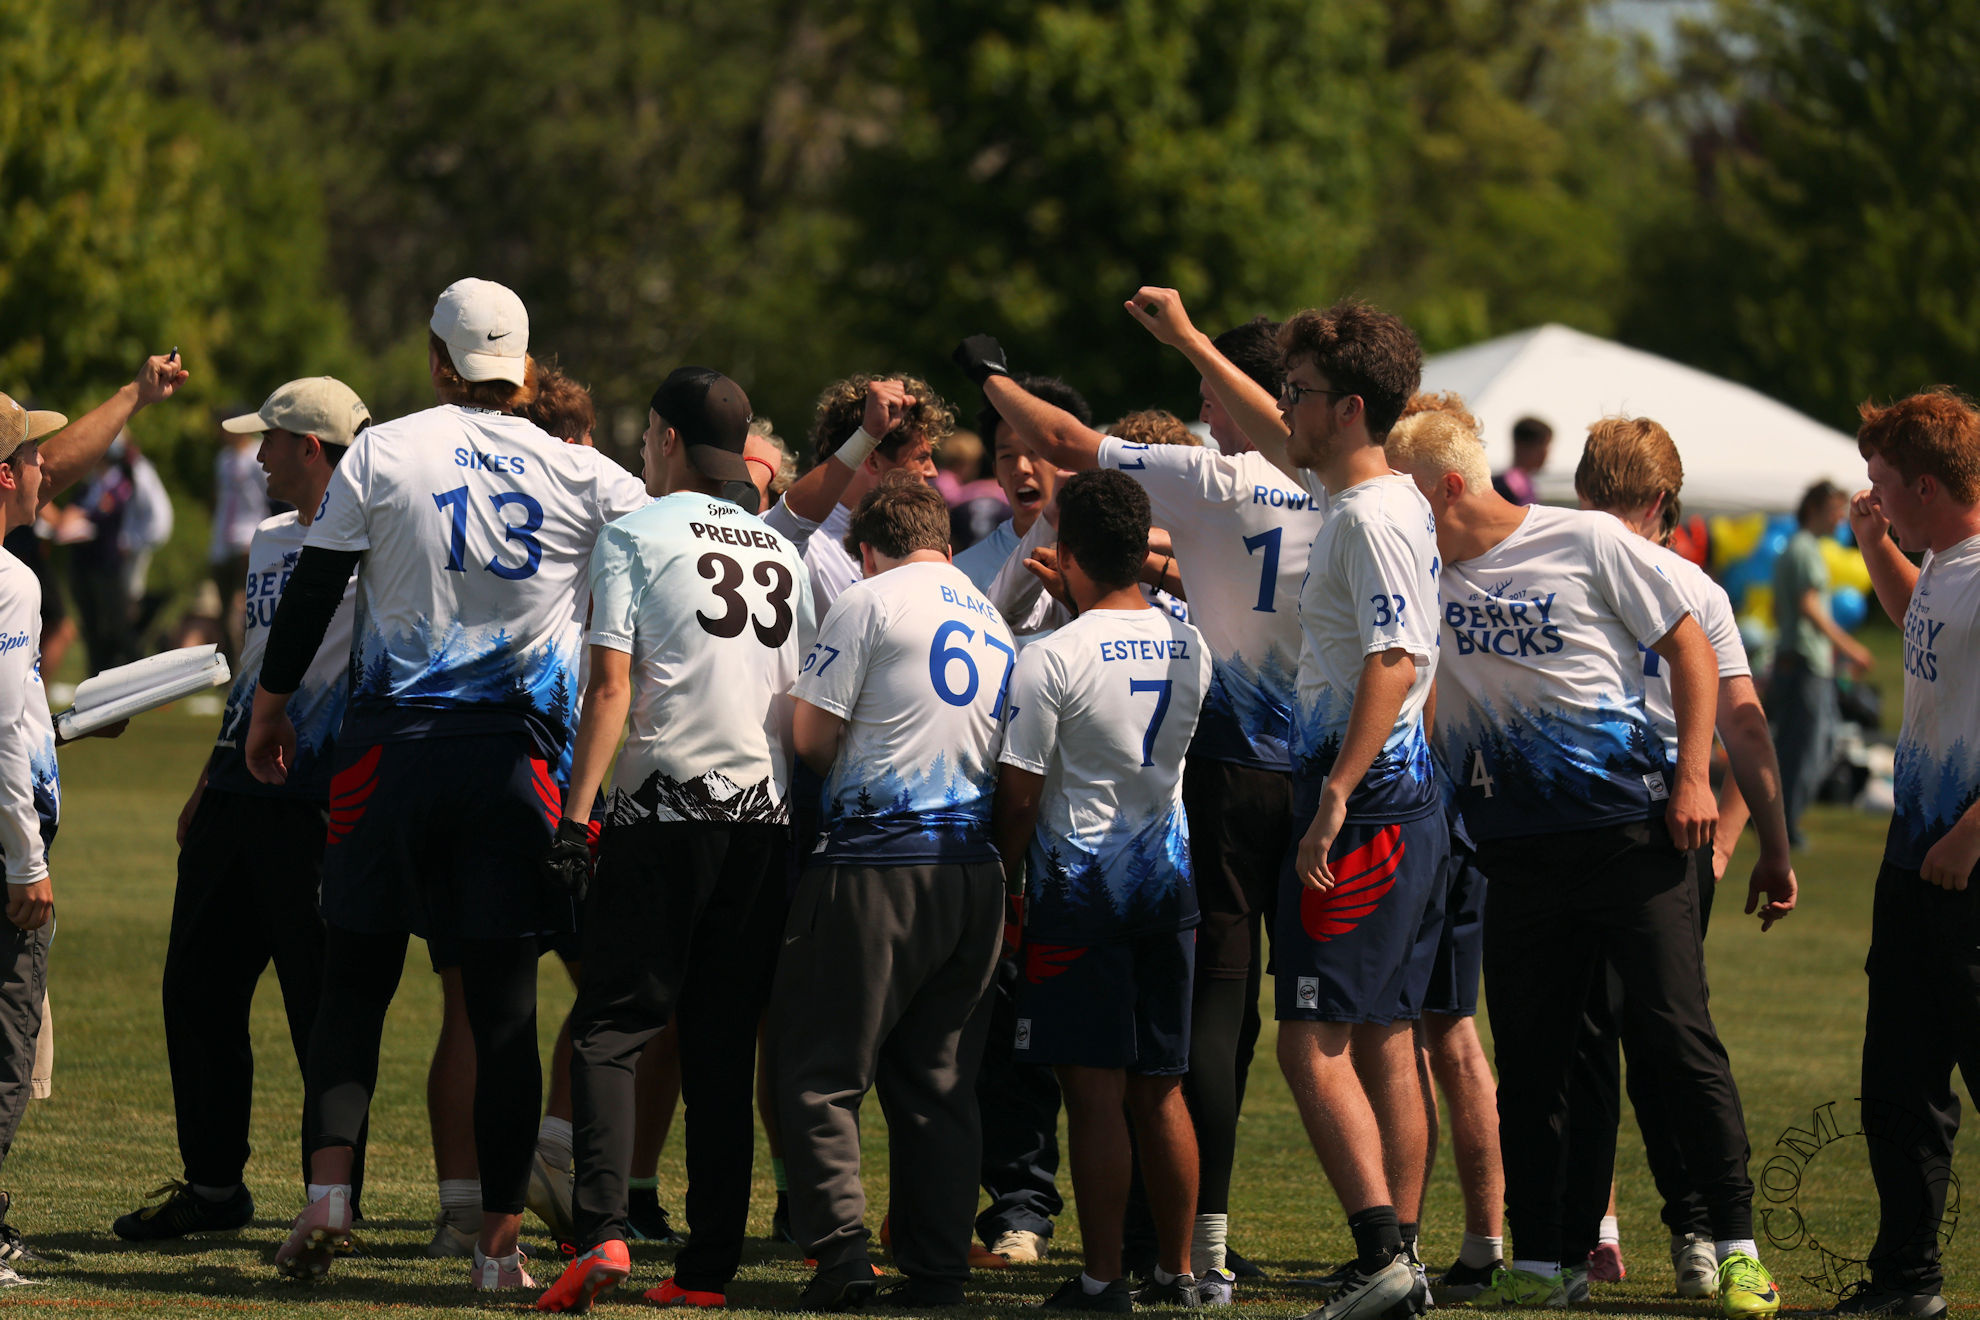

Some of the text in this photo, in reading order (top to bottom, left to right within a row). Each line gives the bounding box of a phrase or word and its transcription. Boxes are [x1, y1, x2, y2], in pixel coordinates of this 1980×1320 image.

[454, 447, 525, 475] SIKES
[708, 503, 739, 519] Spin
[432, 485, 544, 580] 13
[689, 522, 782, 552] PREUER
[696, 552, 793, 648] 33
[940, 585, 998, 624] BLAKE
[1370, 594, 1406, 628] 32
[1445, 592, 1556, 628] BERRY
[1508, 590, 1527, 601] 2017
[0, 630, 29, 656] Spin
[1100, 640, 1190, 662] ESTEVEZ
[1453, 625, 1564, 657] BUCKS
[802, 643, 841, 678] 67
[929, 620, 1014, 722] 67
[1129, 677, 1173, 767] 7
[1470, 750, 1495, 799] 4
